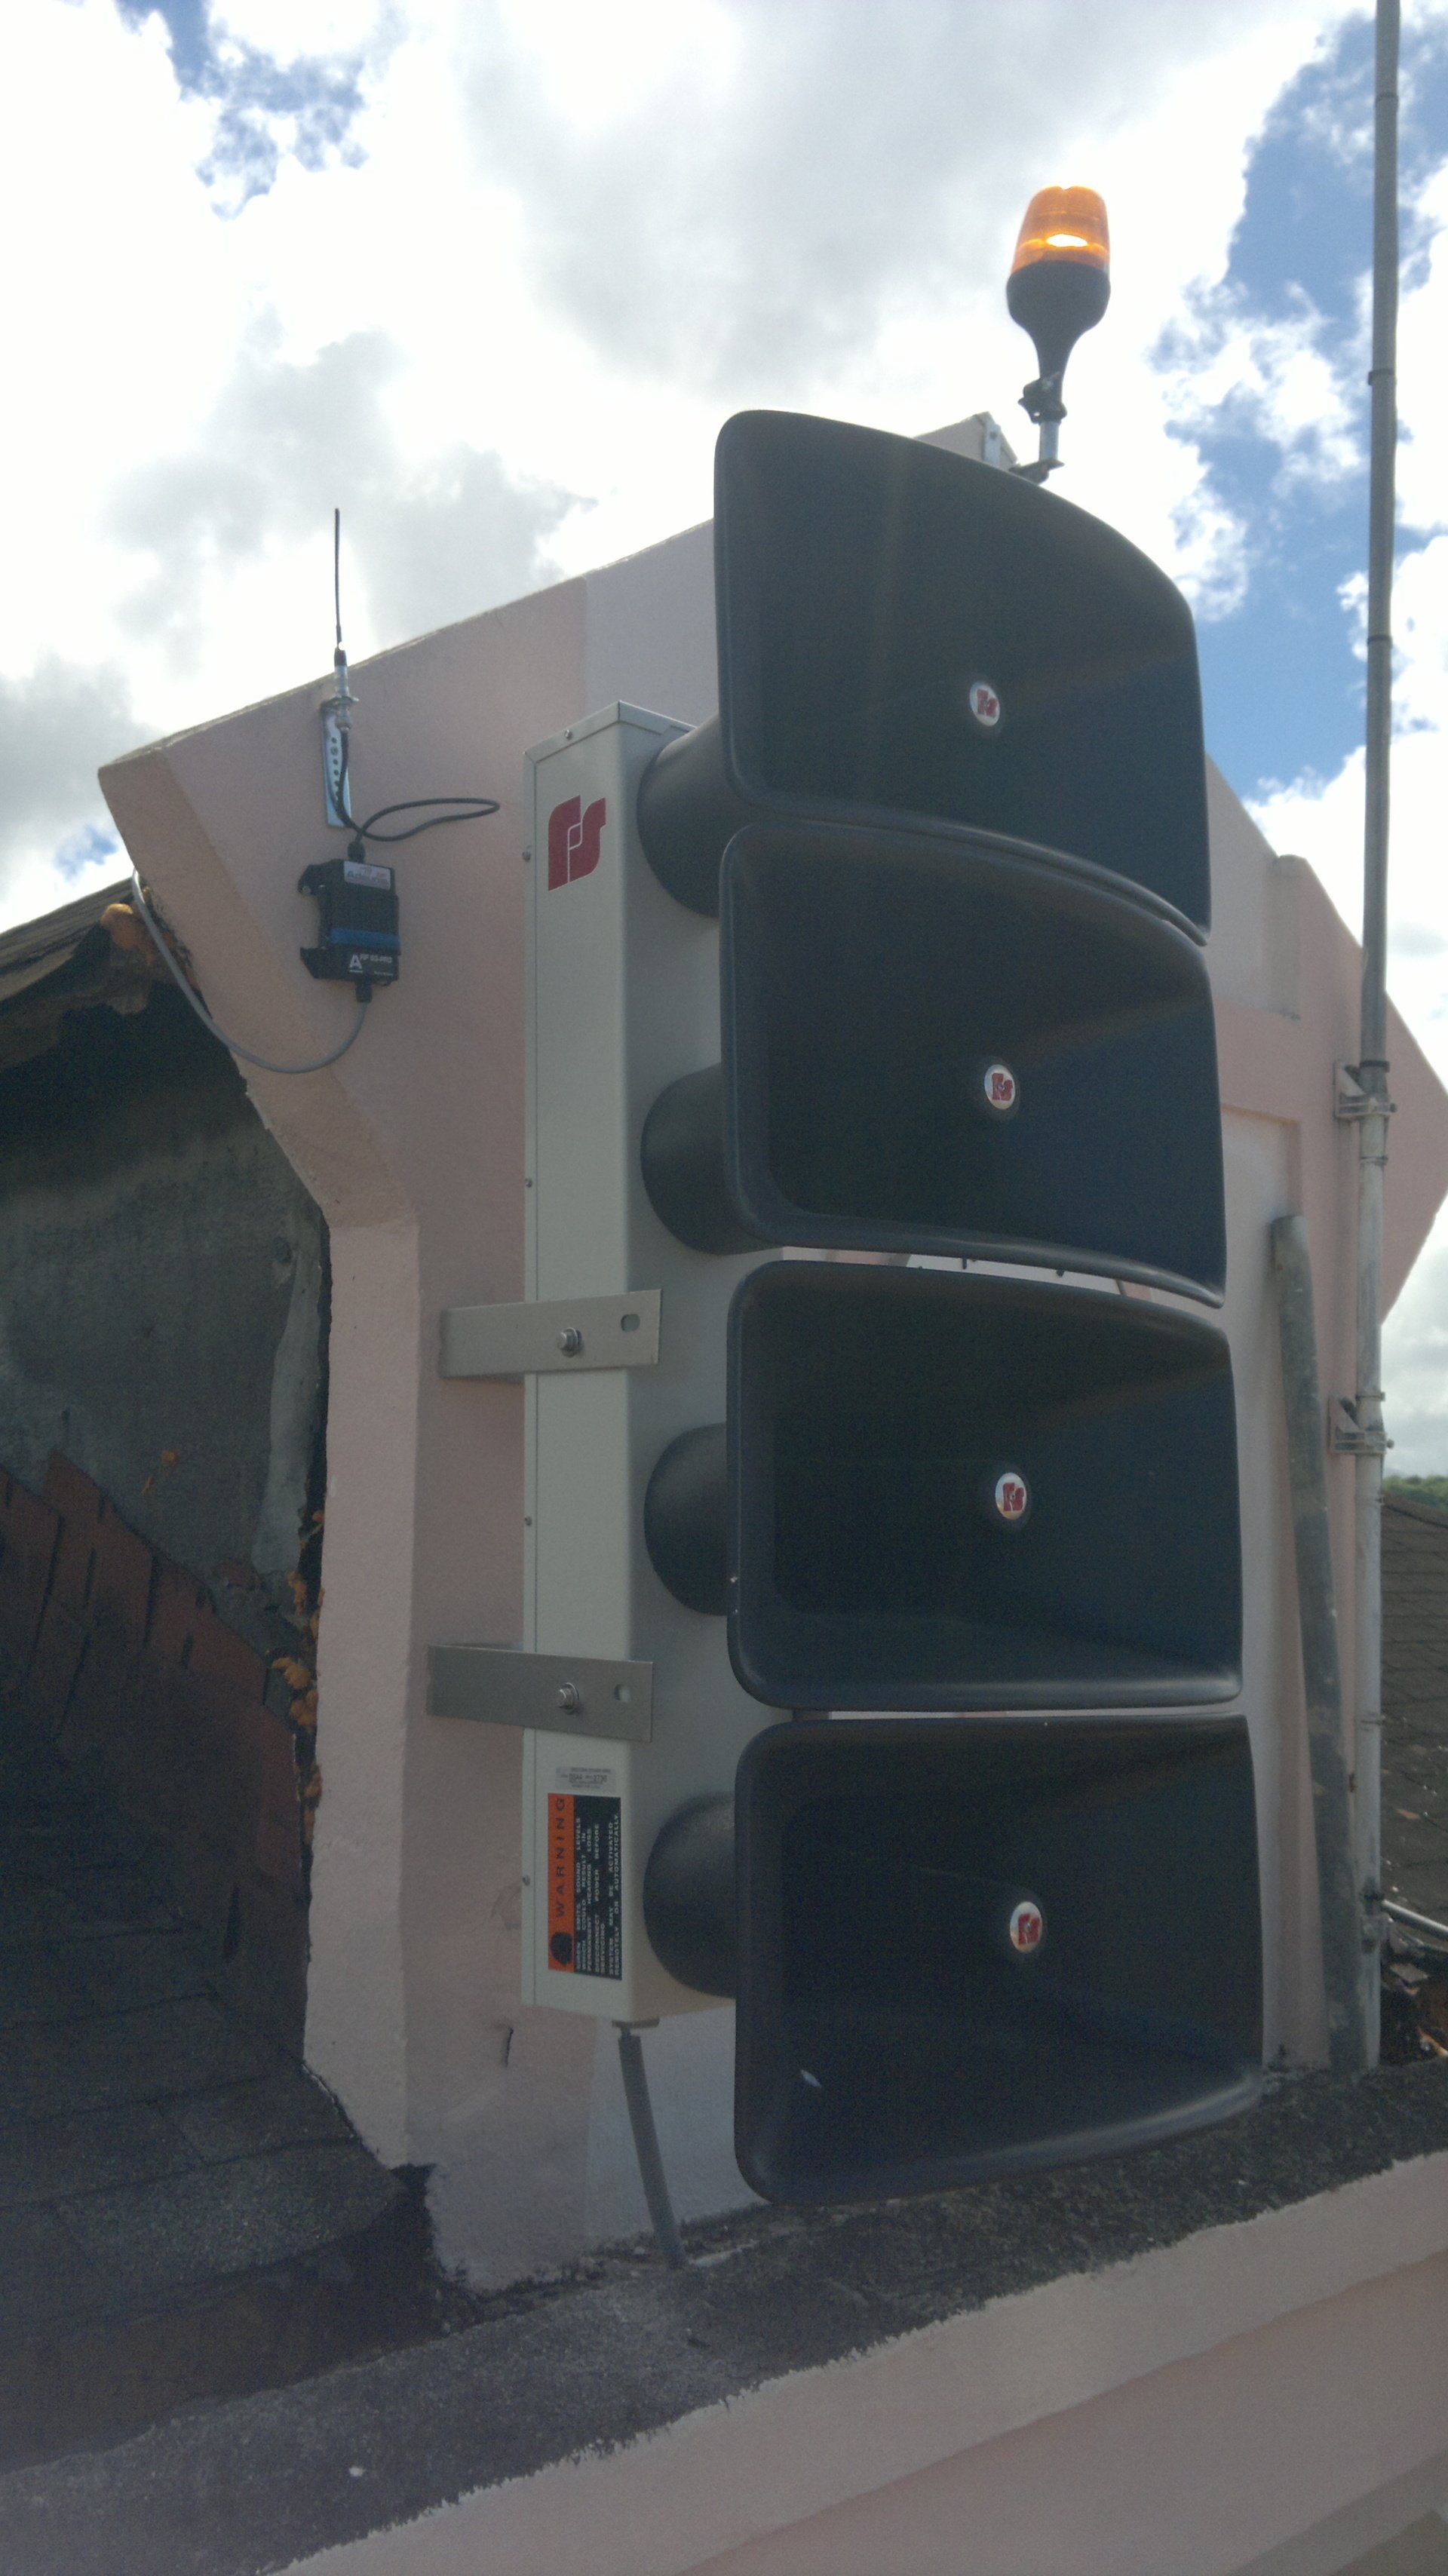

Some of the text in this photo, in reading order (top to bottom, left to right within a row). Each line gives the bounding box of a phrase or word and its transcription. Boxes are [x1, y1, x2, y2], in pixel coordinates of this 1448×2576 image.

[581, 1832, 587, 1842] IN
[555, 1798, 566, 1918] WARNING
[615, 1901, 619, 1914] OR
